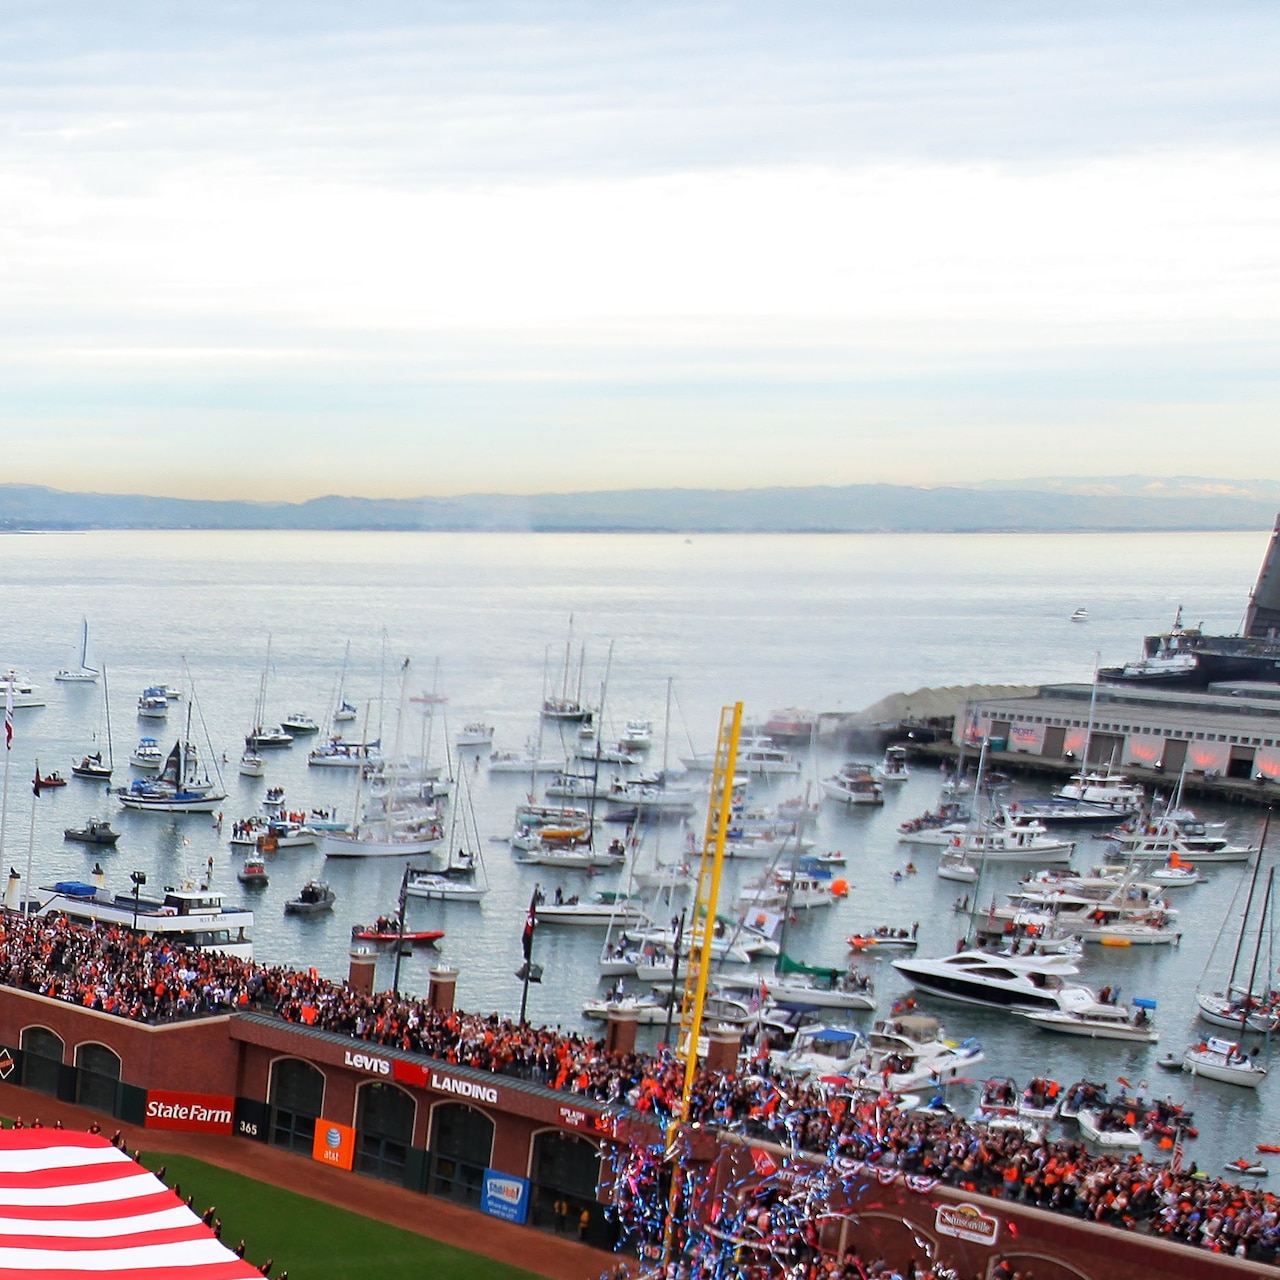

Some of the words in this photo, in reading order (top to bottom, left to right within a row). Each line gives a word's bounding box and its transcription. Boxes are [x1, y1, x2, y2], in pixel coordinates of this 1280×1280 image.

[431, 1074, 498, 1103] LANDING
[146, 1101, 189, 1120] State
[188, 1104, 232, 1123] Farm
[239, 1120, 258, 1136] 365
[323, 1149, 340, 1163] at&t
